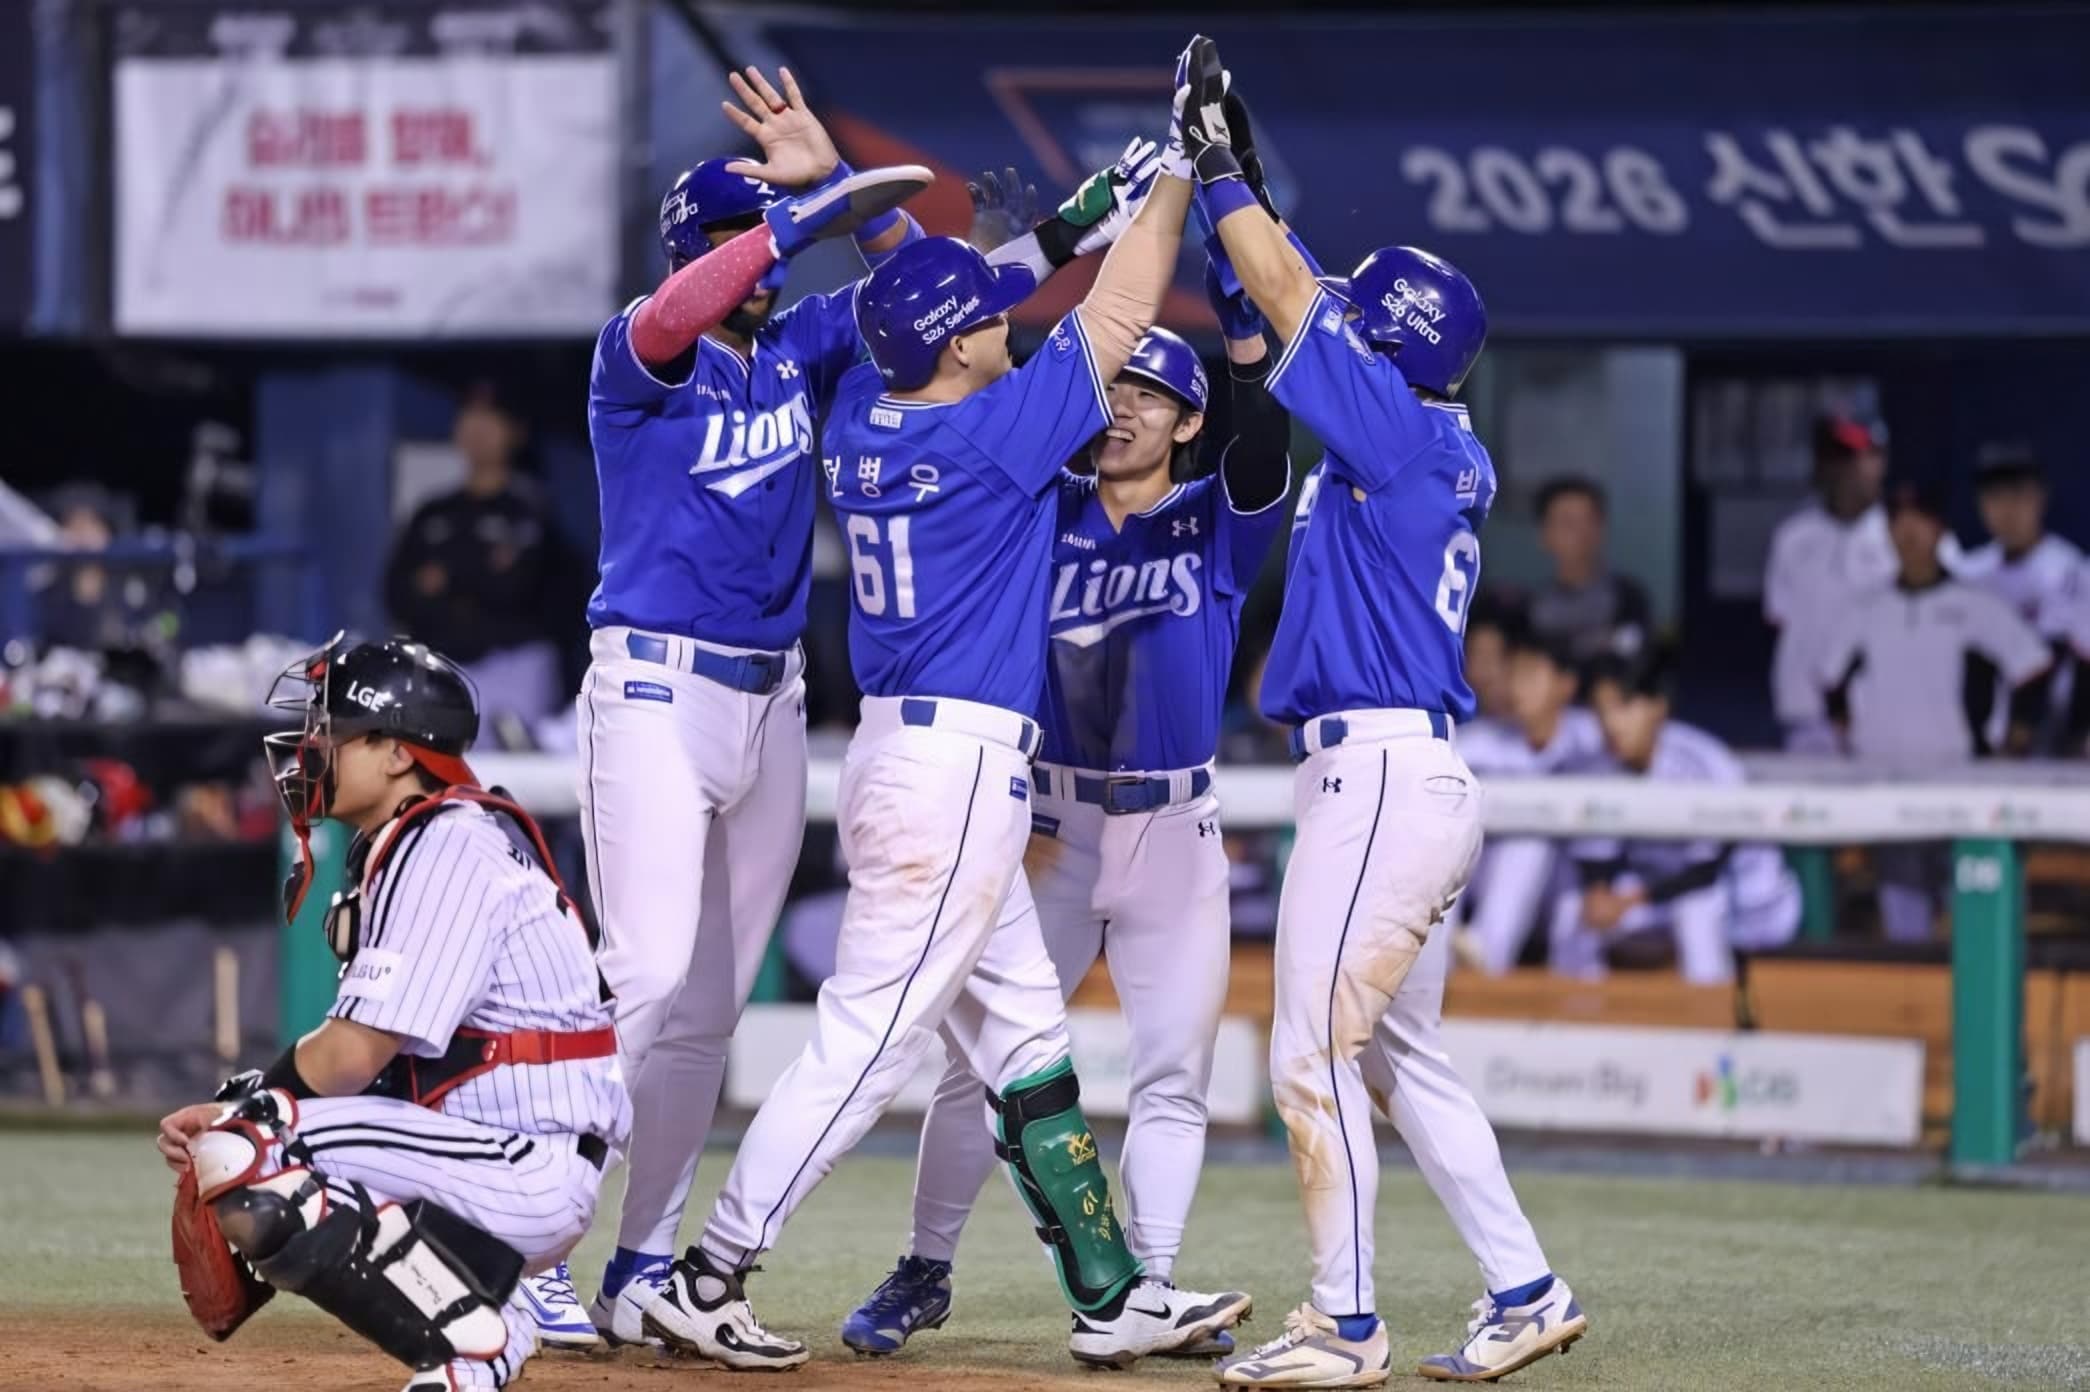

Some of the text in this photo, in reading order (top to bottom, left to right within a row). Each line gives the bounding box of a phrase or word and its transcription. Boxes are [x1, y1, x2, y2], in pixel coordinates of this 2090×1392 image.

[1404, 145, 1690, 234] 2026
[1705, 125, 1986, 249] 신한
[913, 295, 959, 332] Galaxy
[947, 295, 981, 329] Series
[1380, 292, 1443, 346] S26 Ultra
[1393, 277, 1447, 324] Galaxy
[688, 391, 814, 475] Lions
[847, 513, 916, 619] 61
[1049, 552, 1202, 617] Lions
[1435, 530, 1481, 636] 6
